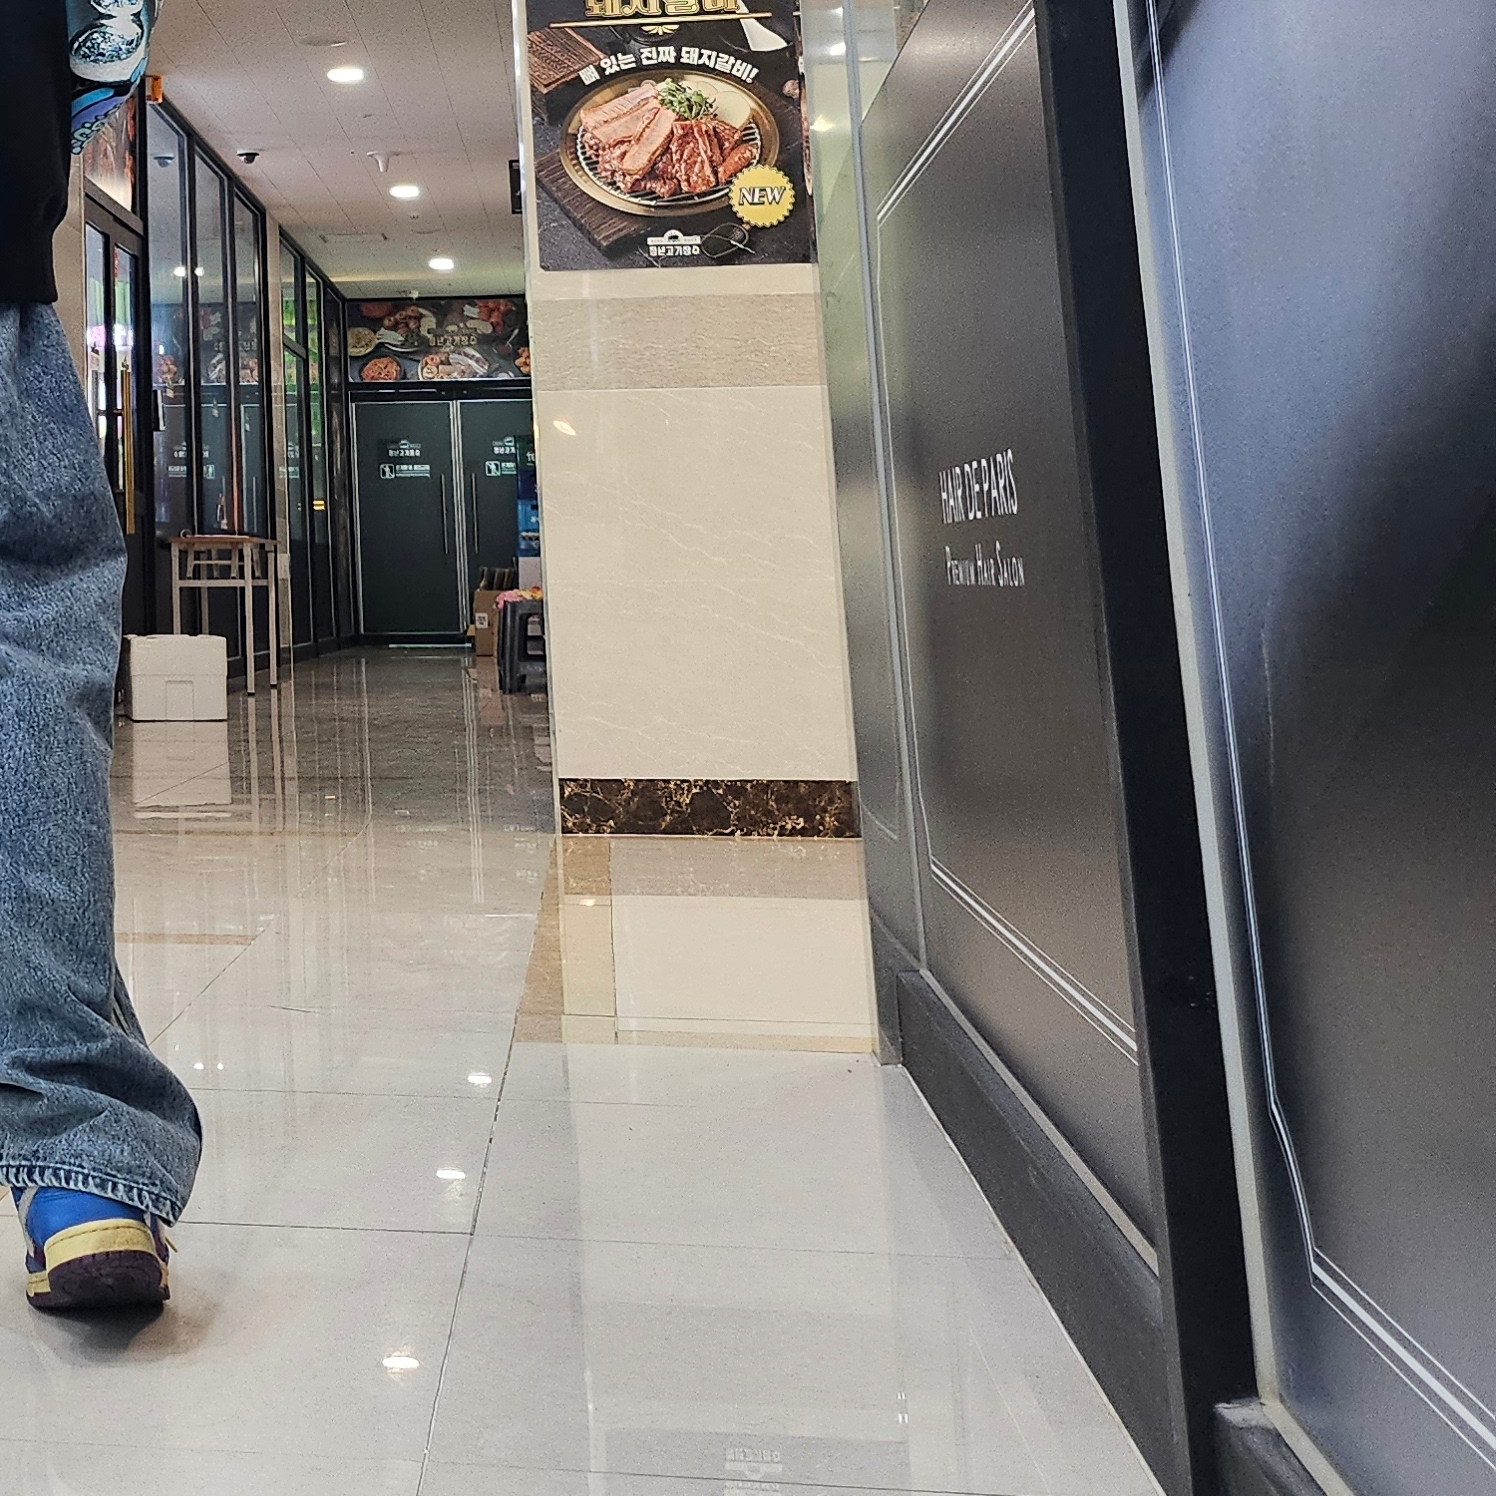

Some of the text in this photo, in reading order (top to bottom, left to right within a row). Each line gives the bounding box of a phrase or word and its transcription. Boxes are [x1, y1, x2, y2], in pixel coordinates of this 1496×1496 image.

[600, 52, 636, 76] 있는
[640, 45, 677, 66] 진짜
[680, 46, 759, 84] 돼지갈비!
[738, 186, 785, 206] NEW
[938, 448, 1018, 524] HAIR DE PARIS
